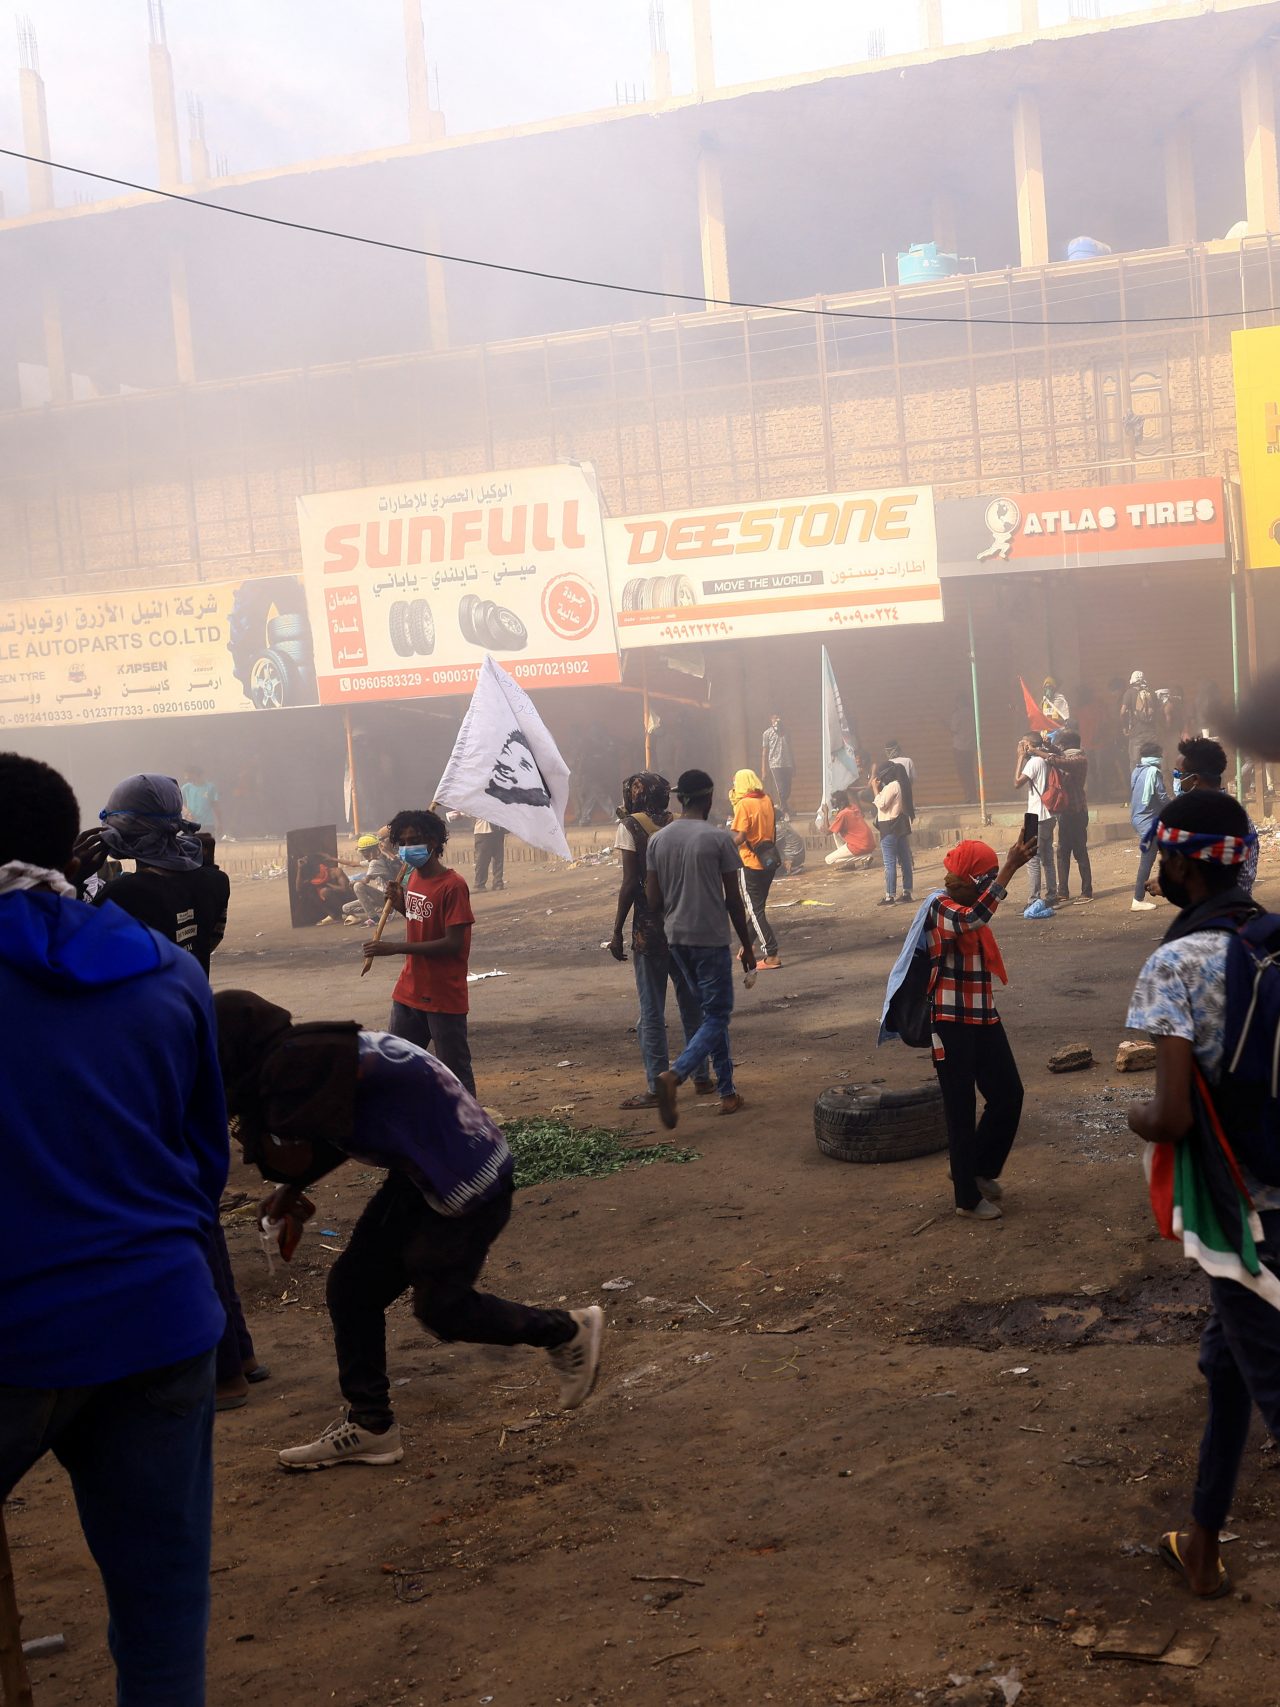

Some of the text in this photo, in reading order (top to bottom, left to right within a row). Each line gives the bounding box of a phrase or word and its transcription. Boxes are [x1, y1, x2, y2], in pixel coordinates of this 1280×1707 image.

[431, 487, 474, 512] الحصري
[477, 482, 513, 504] الوكيل
[1022, 498, 1215, 535] ATLAS TIRES
[323, 500, 585, 574] SUNFULL
[624, 494, 918, 565] DEESTONE
[373, 562, 537, 598] صيني تايلندي ياباني
[714, 573, 812, 593] MOVE THE WORLD
[830, 565, 885, 585] ديستون
[132, 600, 169, 625] النيل
[174, 593, 218, 619] شركة
[328, 591, 358, 611] ضمان
[331, 616, 360, 633] لمدة
[25, 633, 143, 658] AUTOPARTS
[149, 626, 221, 648] CO.LTD
[337, 646, 364, 664] عام
[19, 671, 46, 681] TYRE
[352, 673, 422, 690] 0960583329
[515, 661, 589, 678] 0907021902
[153, 699, 215, 714] 0920165000
